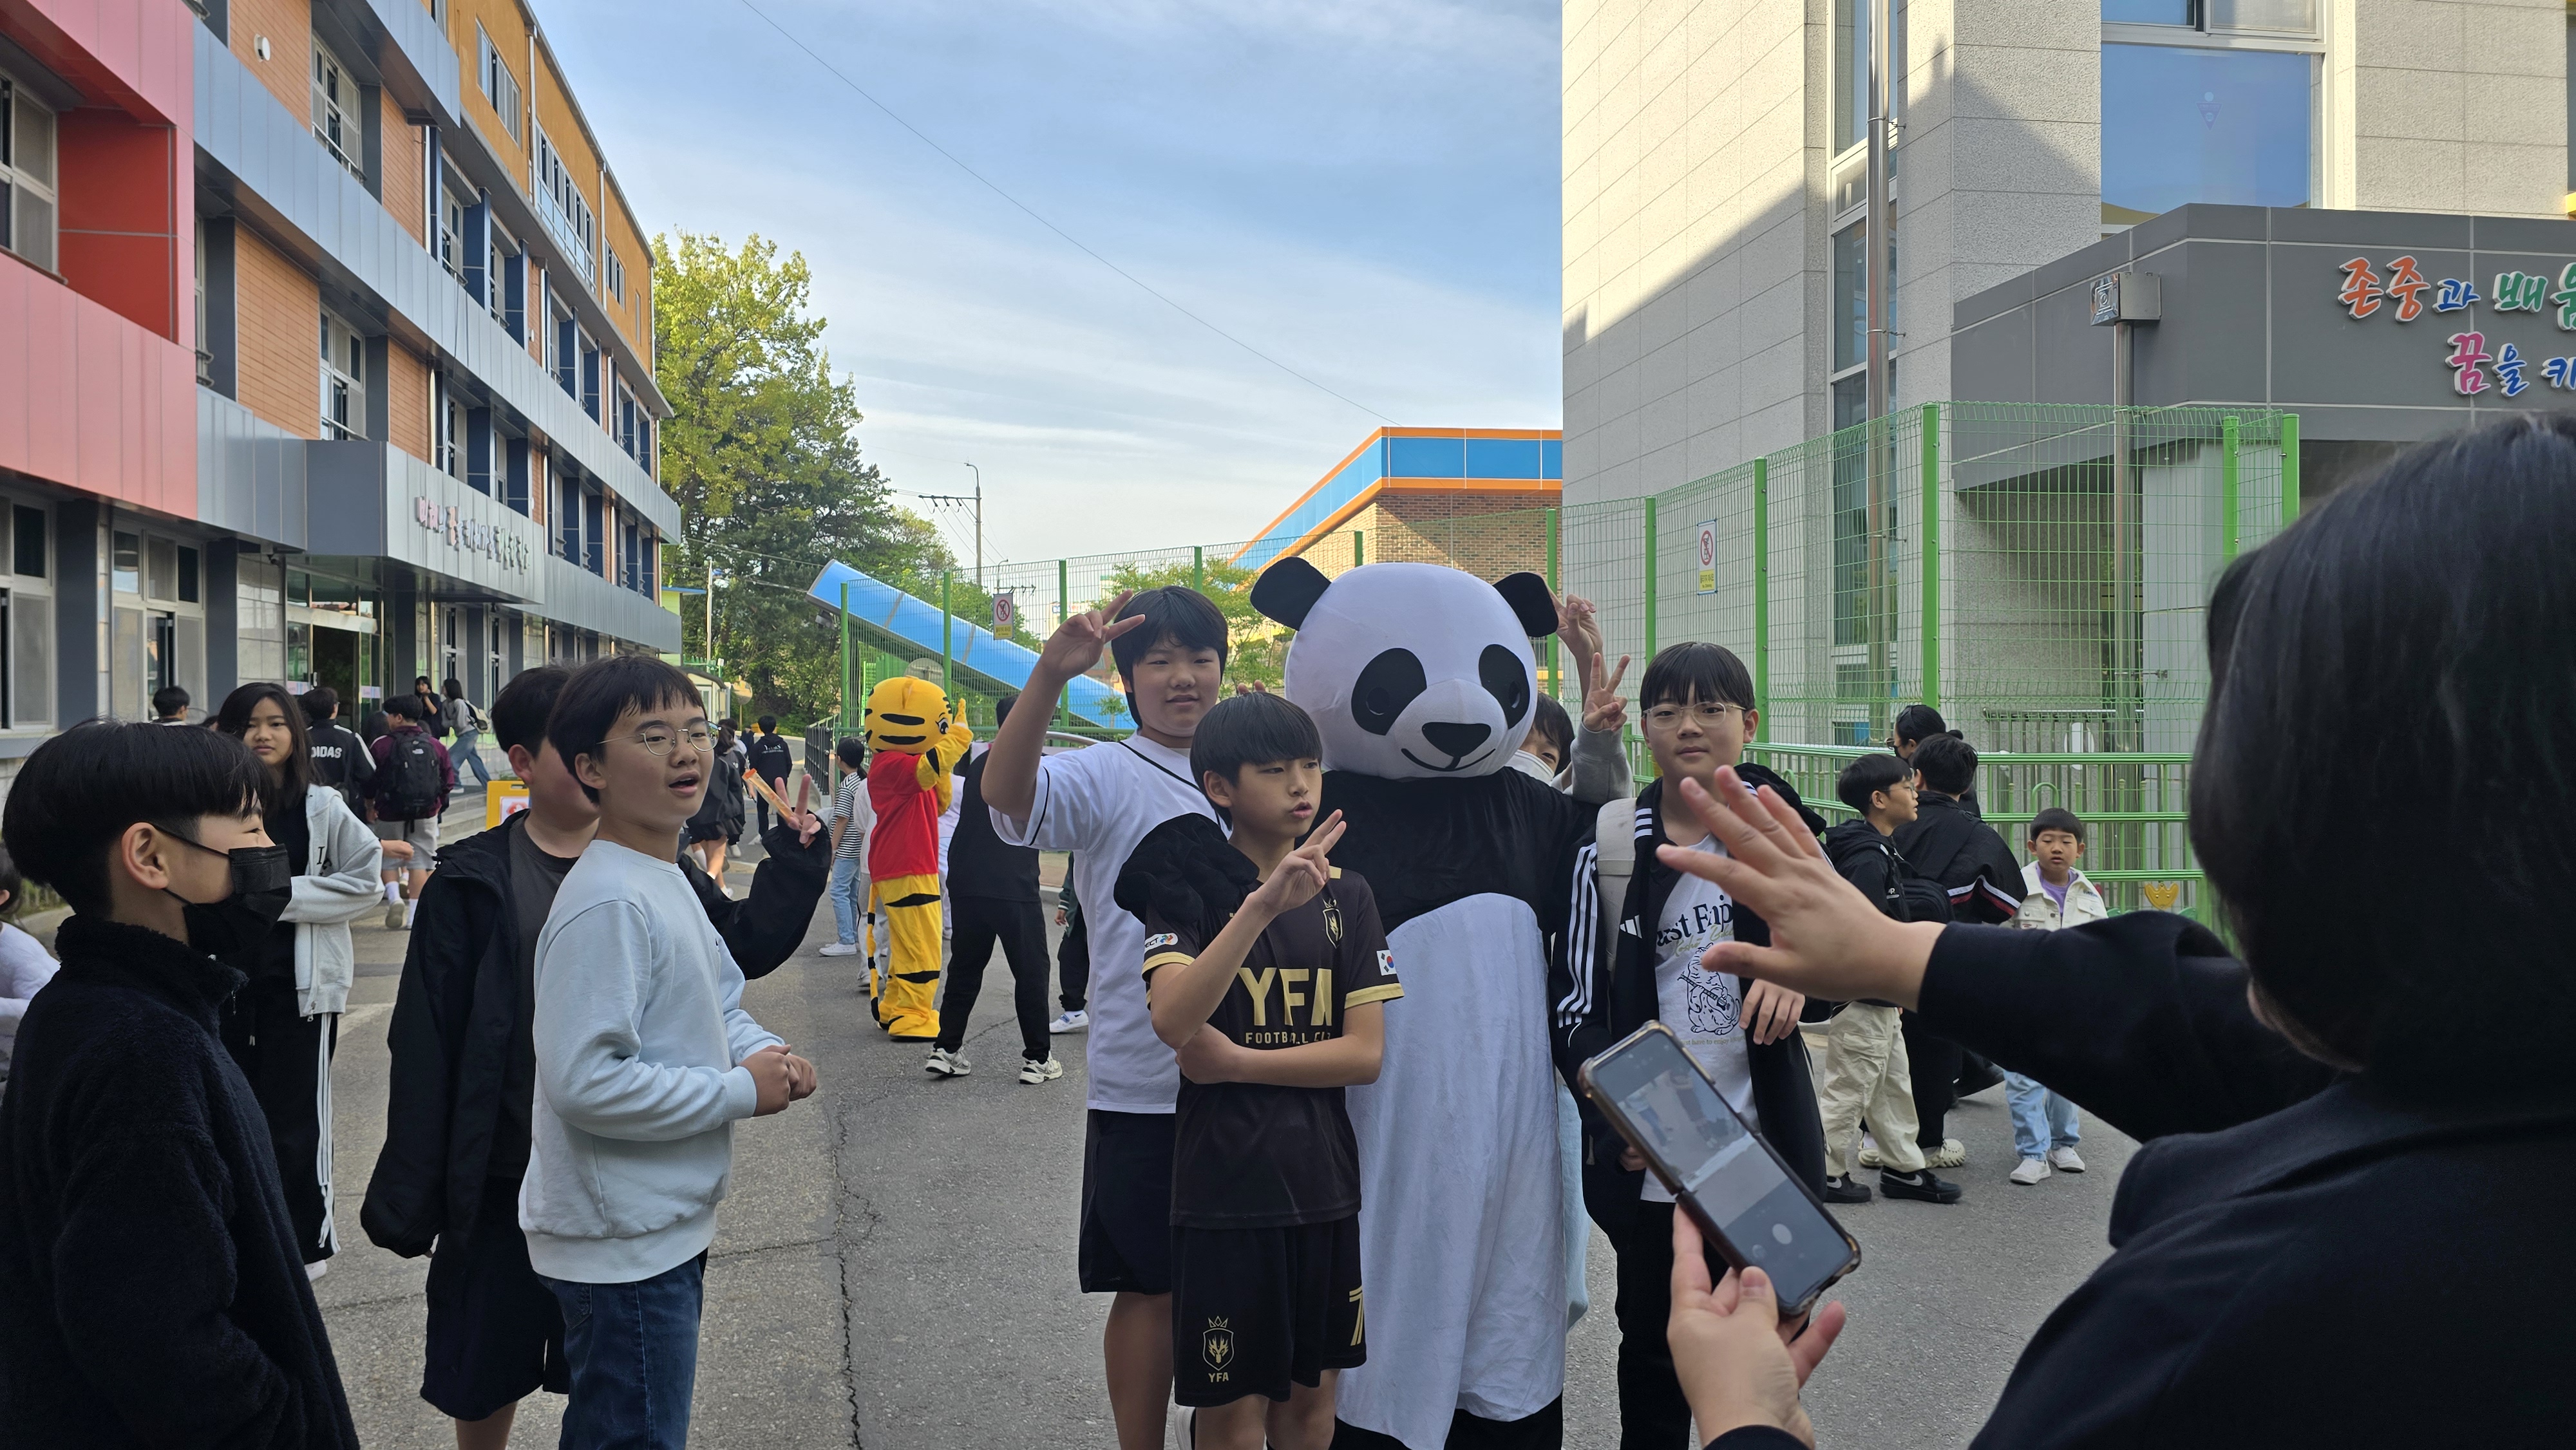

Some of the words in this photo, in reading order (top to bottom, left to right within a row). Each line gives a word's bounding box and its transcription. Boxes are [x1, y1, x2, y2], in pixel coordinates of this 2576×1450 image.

[2337, 255, 2481, 322] 존중과
[2445, 331, 2530, 397] 꿈을
[311, 746, 343, 758] DIDAS
[1144, 937, 1159, 948] ECT
[1238, 967, 1332, 1026] YFA
[1245, 1031, 1309, 1044] FOOTBAL
[1208, 1371, 1229, 1383] YFA
